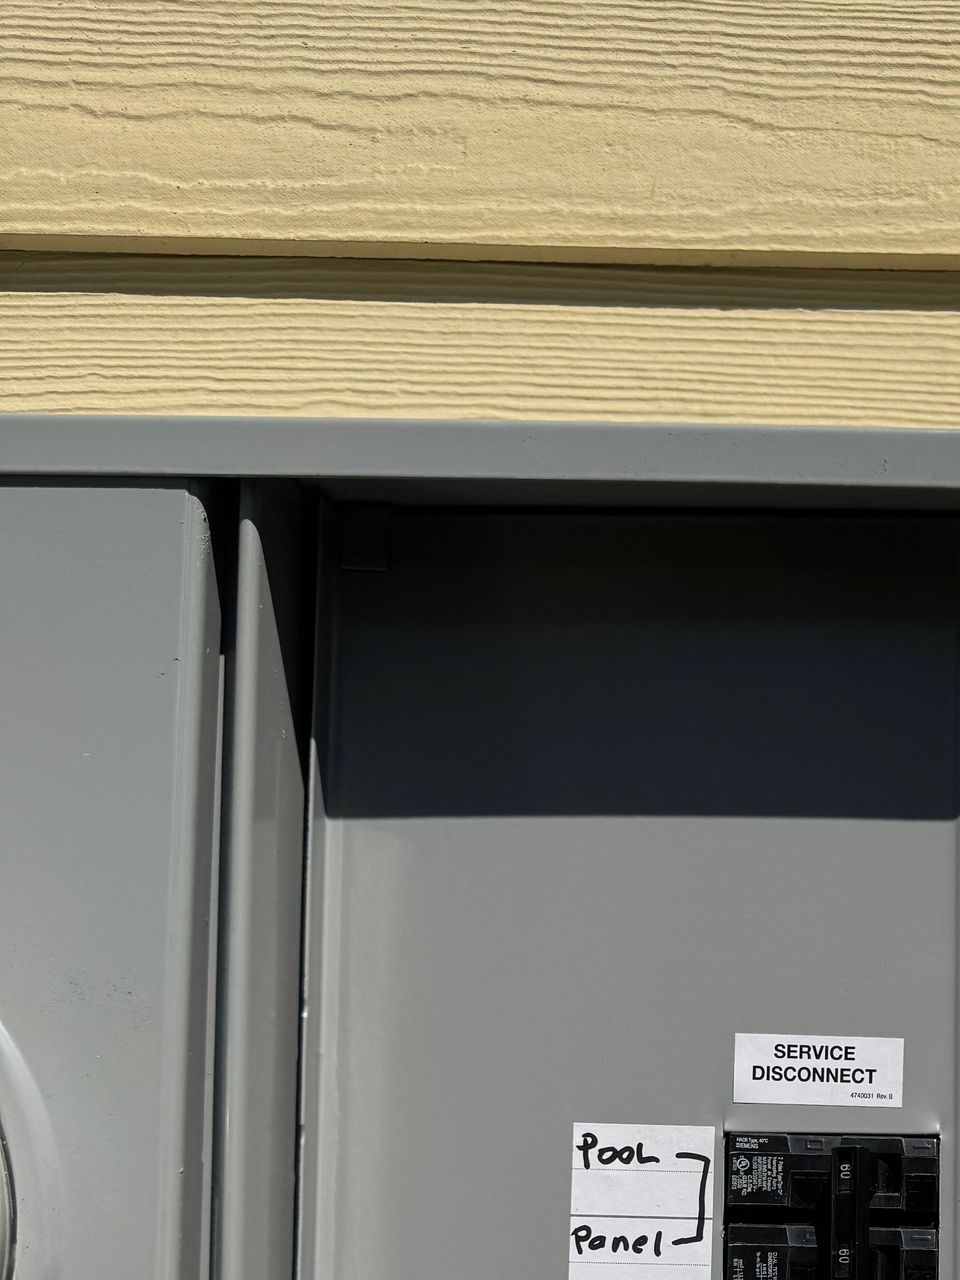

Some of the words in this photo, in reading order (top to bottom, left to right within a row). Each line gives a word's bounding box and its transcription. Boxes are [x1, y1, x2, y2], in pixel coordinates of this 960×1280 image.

[774, 1044, 855, 1060] SERVICE
[752, 1066, 877, 1083] DISCONNECT
[841, 1164, 851, 1179] 60
[571, 1225, 662, 1257] Panel
[839, 1249, 849, 1263] 60
